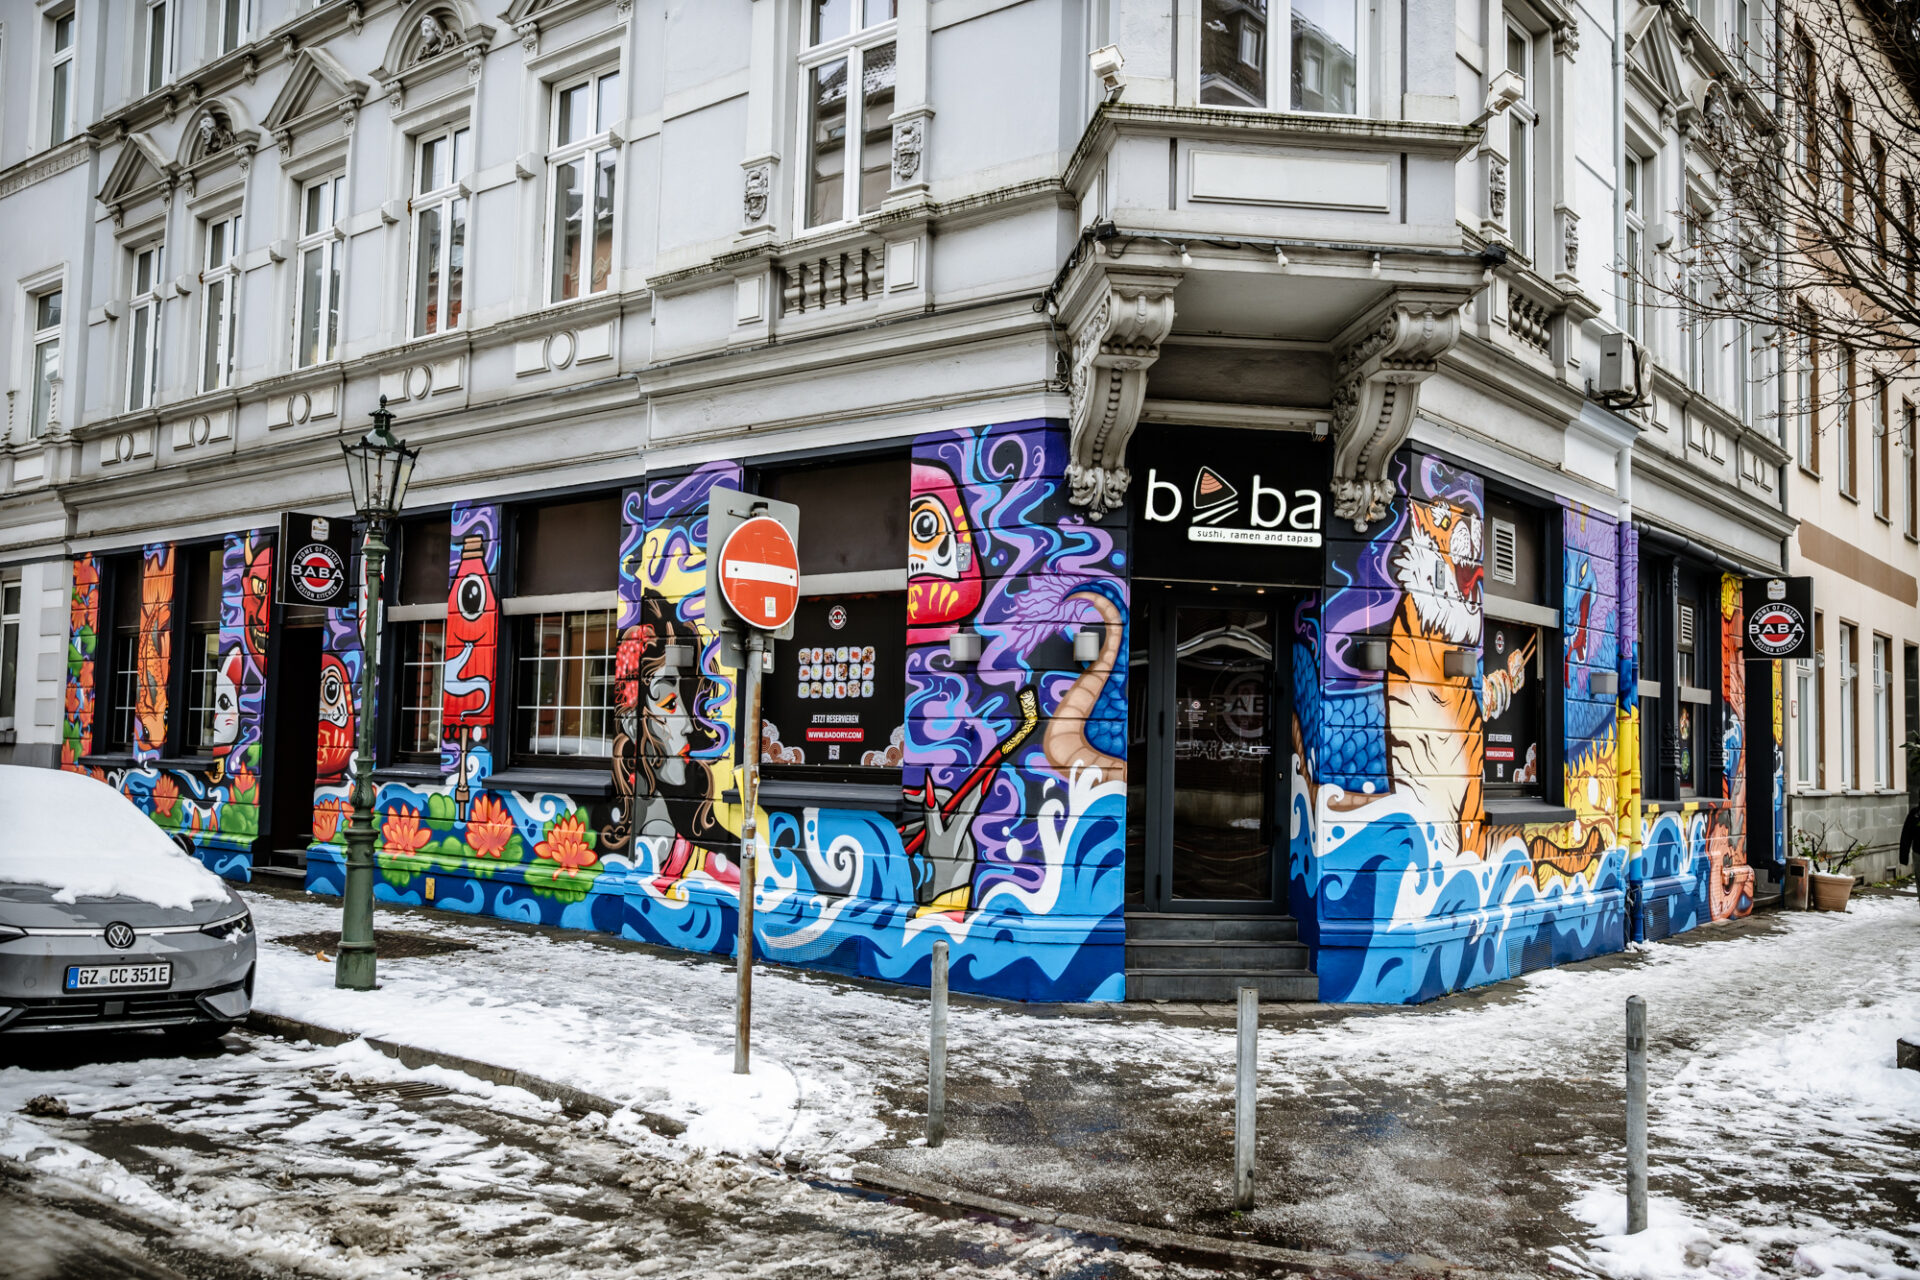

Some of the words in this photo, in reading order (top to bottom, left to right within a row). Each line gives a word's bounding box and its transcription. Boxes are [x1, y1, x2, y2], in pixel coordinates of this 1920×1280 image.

[1197, 529, 1225, 539] sushi,
[1230, 531, 1261, 541] ramen
[1264, 533, 1283, 542] and
[1287, 533, 1314, 544] tapas
[297, 546, 314, 562] HOME
[324, 548, 340, 566] SUSHI
[291, 564, 344, 581] BABA
[297, 581, 315, 599] FUSION
[316, 585, 338, 600] KITCHEN
[1754, 606, 1771, 621] HOME
[1782, 606, 1800, 621] SUSHI
[1749, 623, 1805, 634] BABA
[1755, 638, 1775, 653] FUSION
[1776, 637, 1798, 653] KITCHEN
[811, 714, 826, 724] JETZT
[826, 714, 859, 724] RESERVIEREN
[79, 969, 99, 985] GZ
[109, 968, 128, 983] CC
[131, 966, 168, 983] 351E
